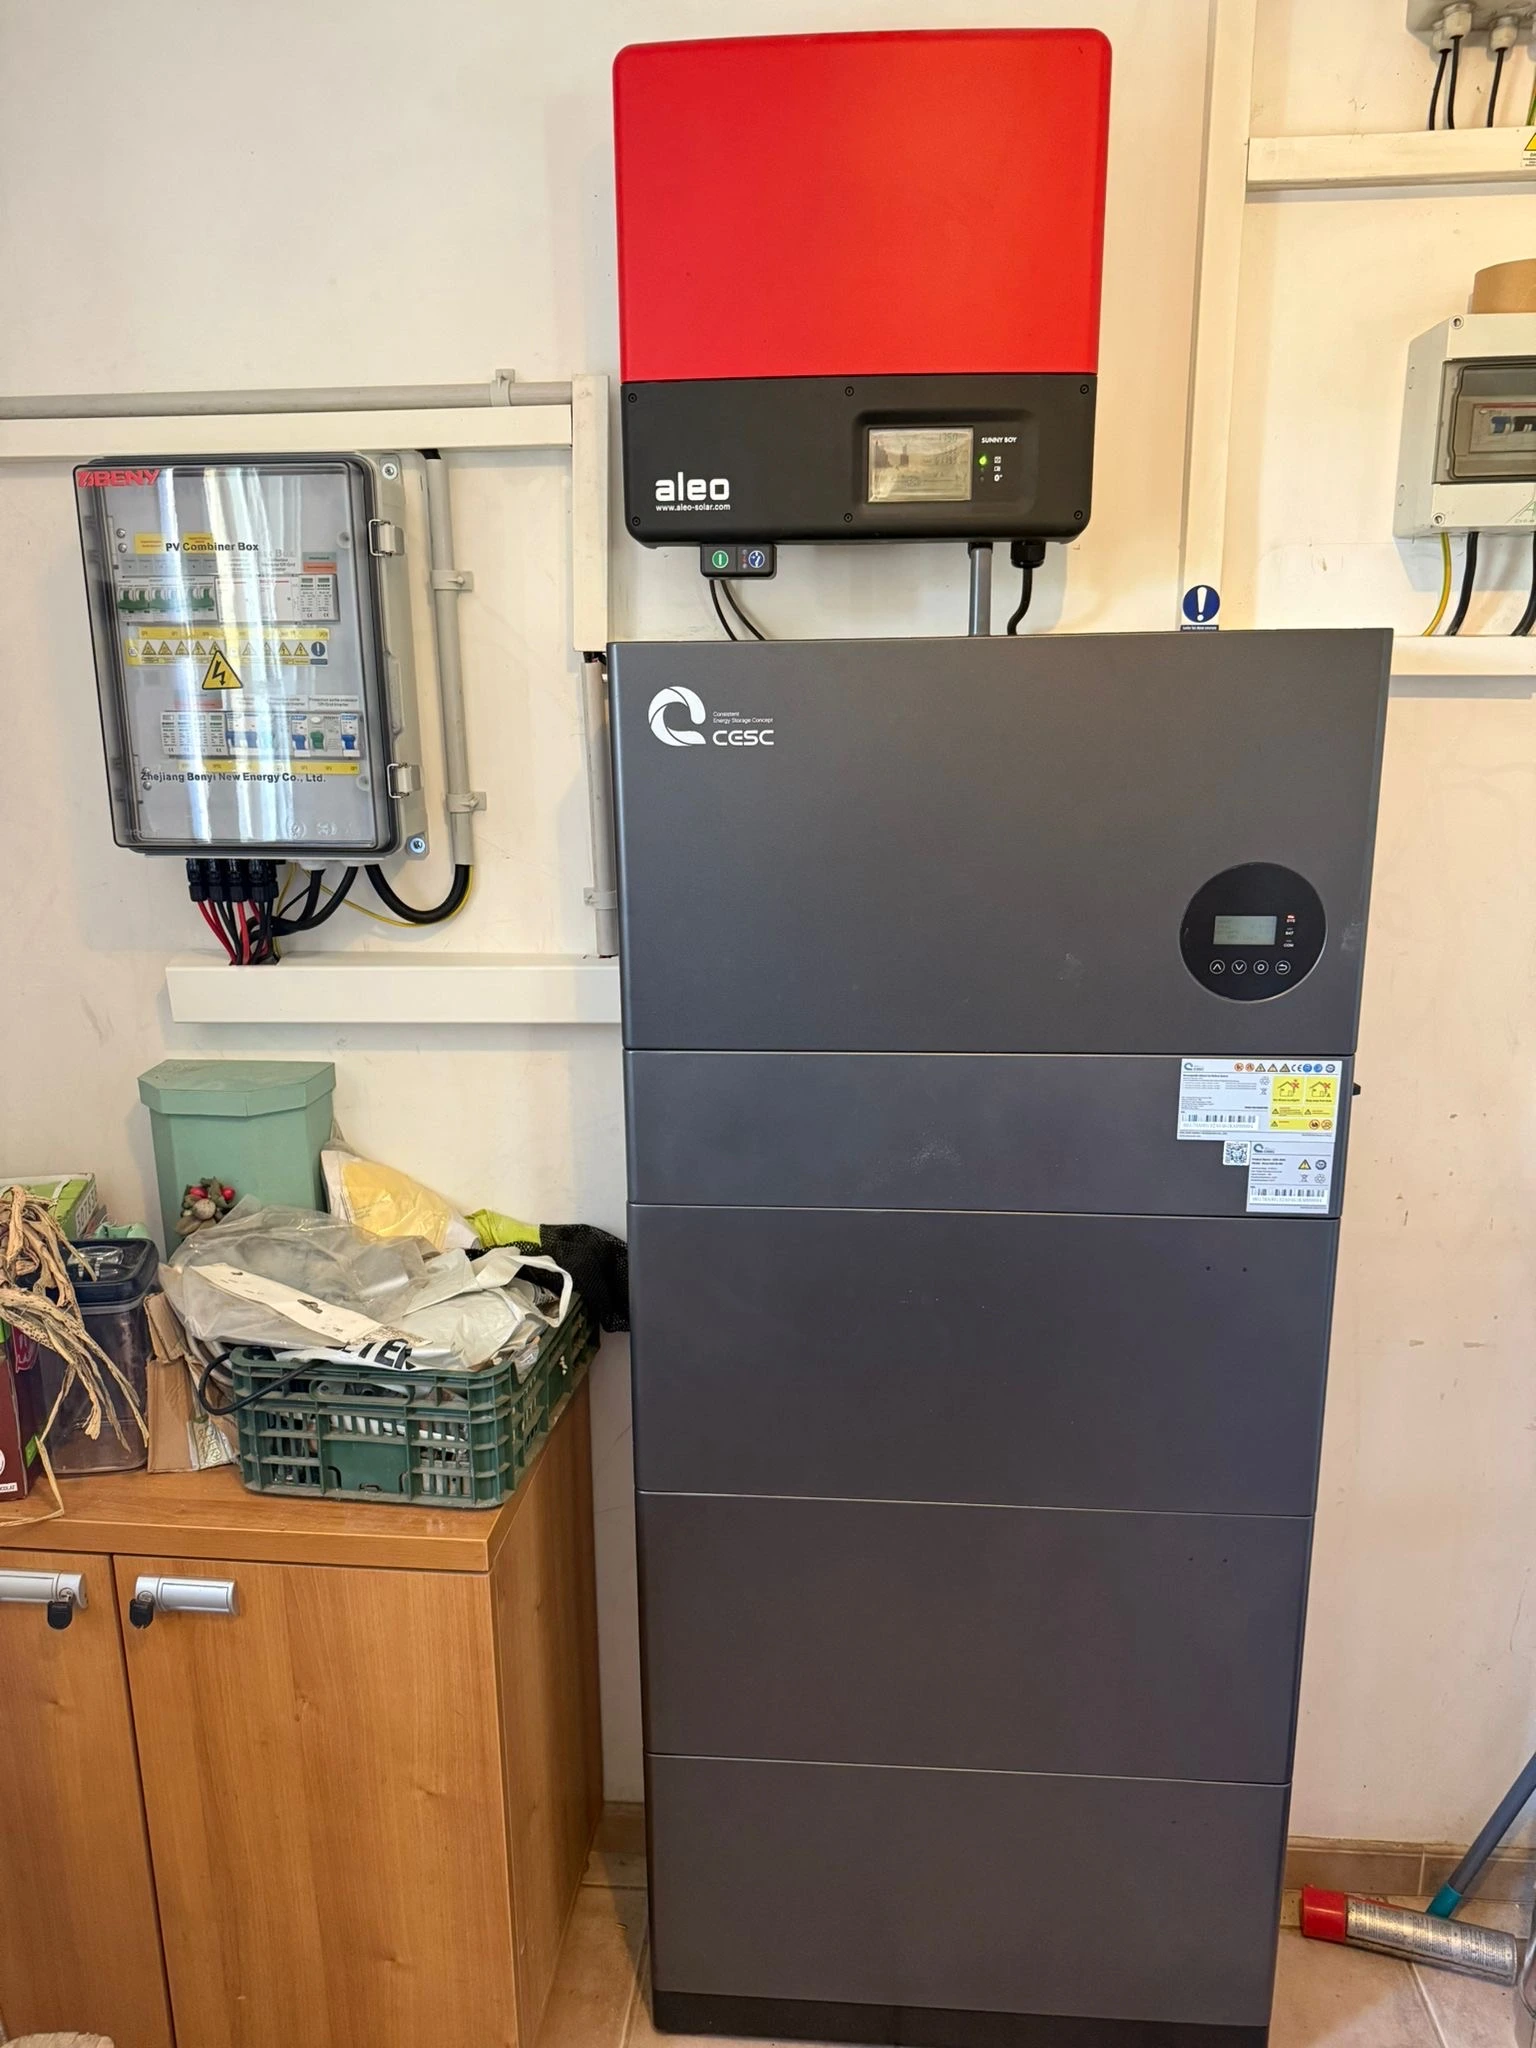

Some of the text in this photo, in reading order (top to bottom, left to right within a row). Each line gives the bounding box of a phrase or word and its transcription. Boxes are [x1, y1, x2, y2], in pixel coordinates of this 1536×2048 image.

[94, 468, 161, 487] BENY
[655, 471, 730, 502] aleo
[655, 503, 731, 511] www.aleo-solar.com
[165, 542, 180, 552] PV
[182, 542, 235, 552] Combiner
[237, 542, 259, 552] Box
[712, 729, 774, 746] CESC
[140, 771, 326, 784] Zhejiang Benyi New Energy Co., Ltd.
